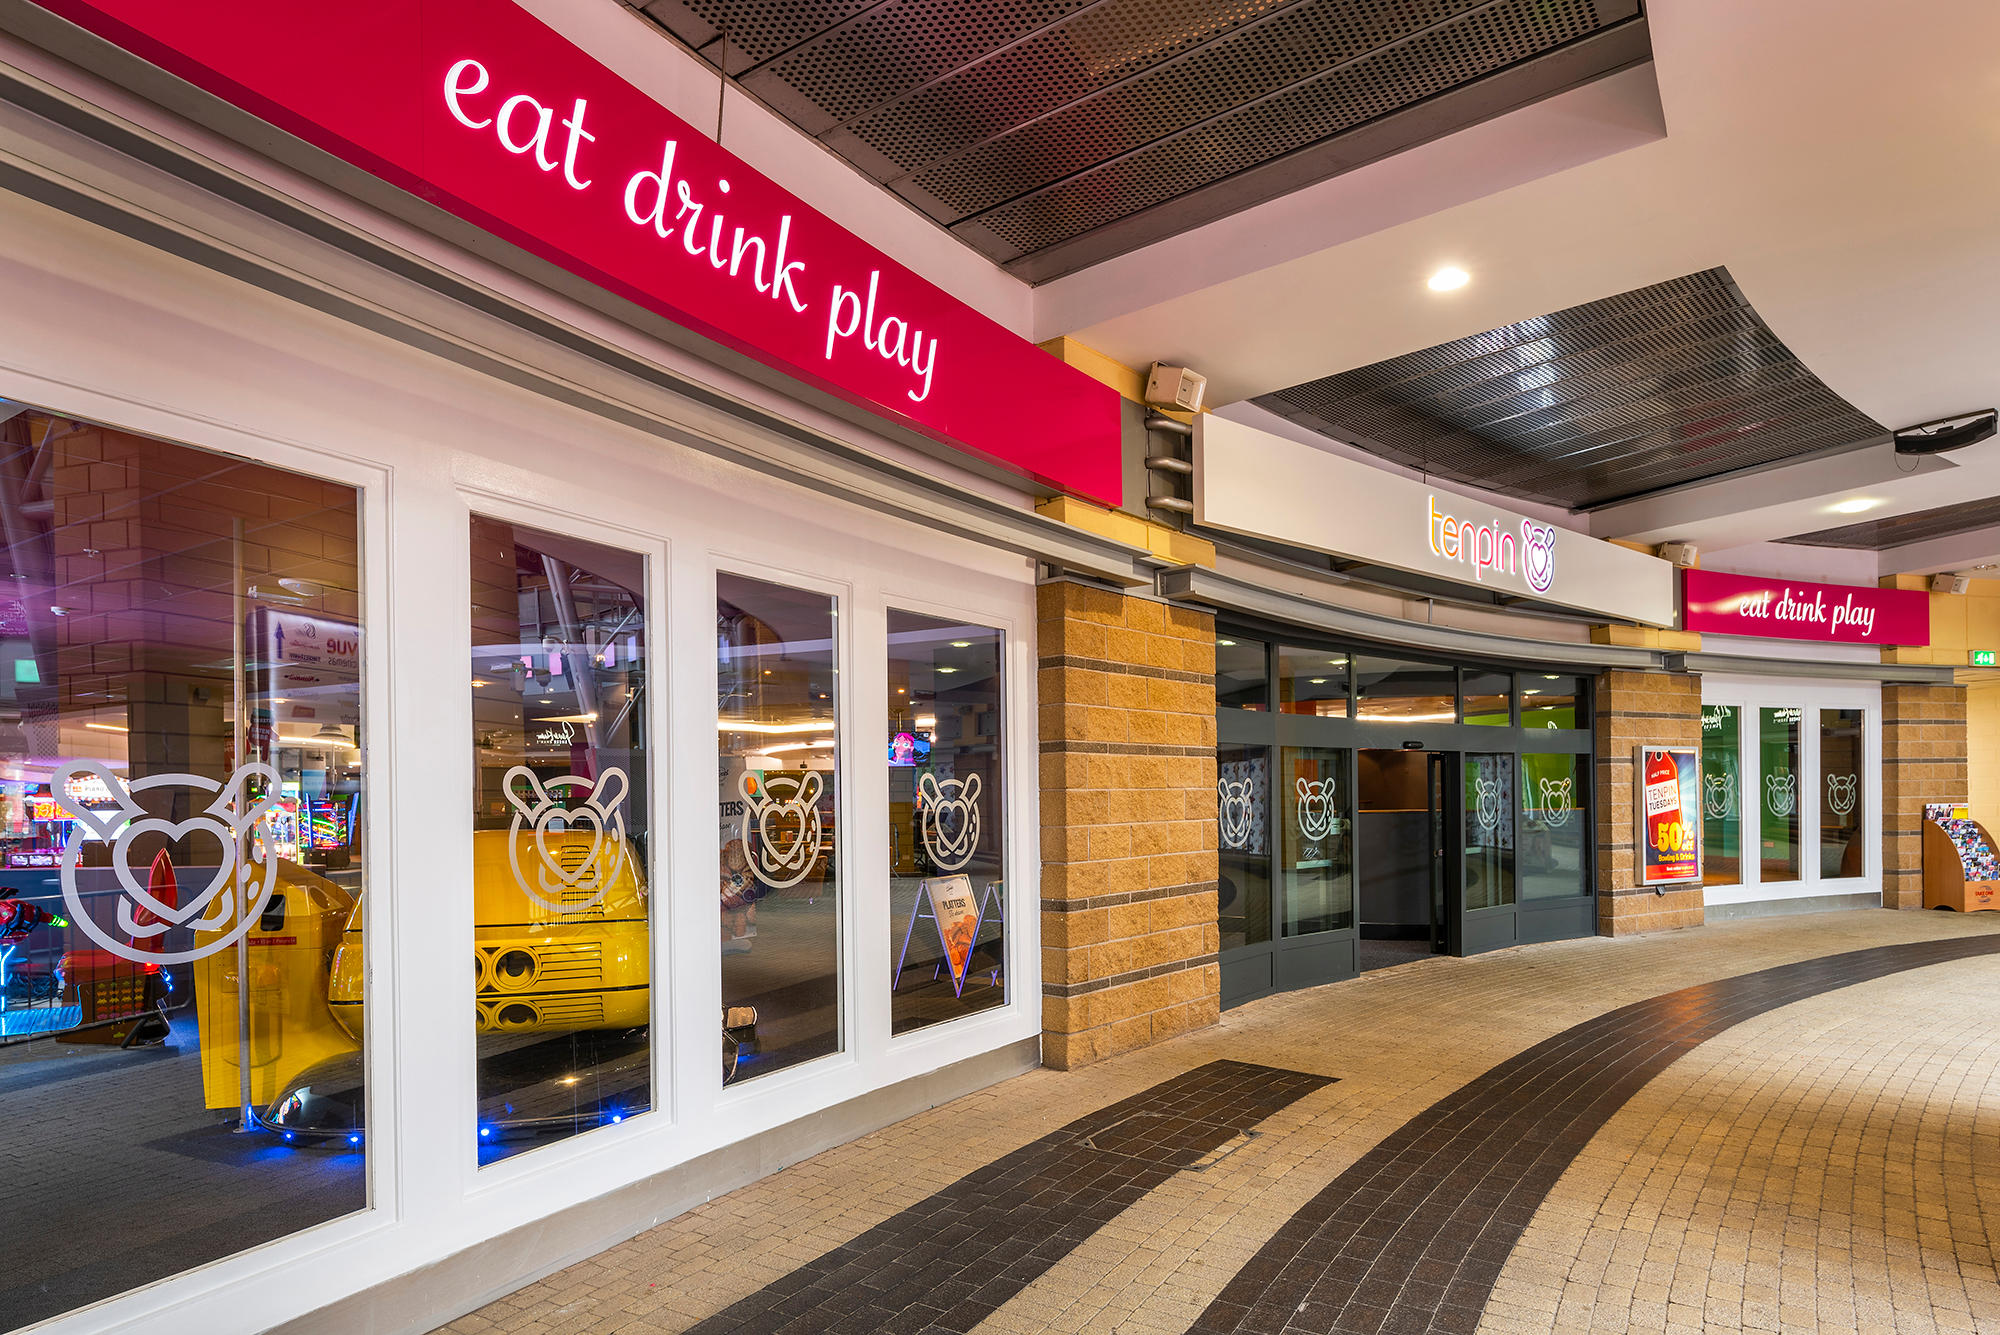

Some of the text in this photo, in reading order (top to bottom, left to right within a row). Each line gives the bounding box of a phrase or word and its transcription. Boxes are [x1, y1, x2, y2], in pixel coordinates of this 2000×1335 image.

[443, 58, 939, 403] eat drink play
[1429, 495, 1516, 581] tenpin
[1740, 587, 1876, 637] eat drink play
[1648, 784, 1676, 801] TENPIN
[1649, 796, 1678, 811] TUESDAYS
[942, 898, 966, 911] PLATTERS
